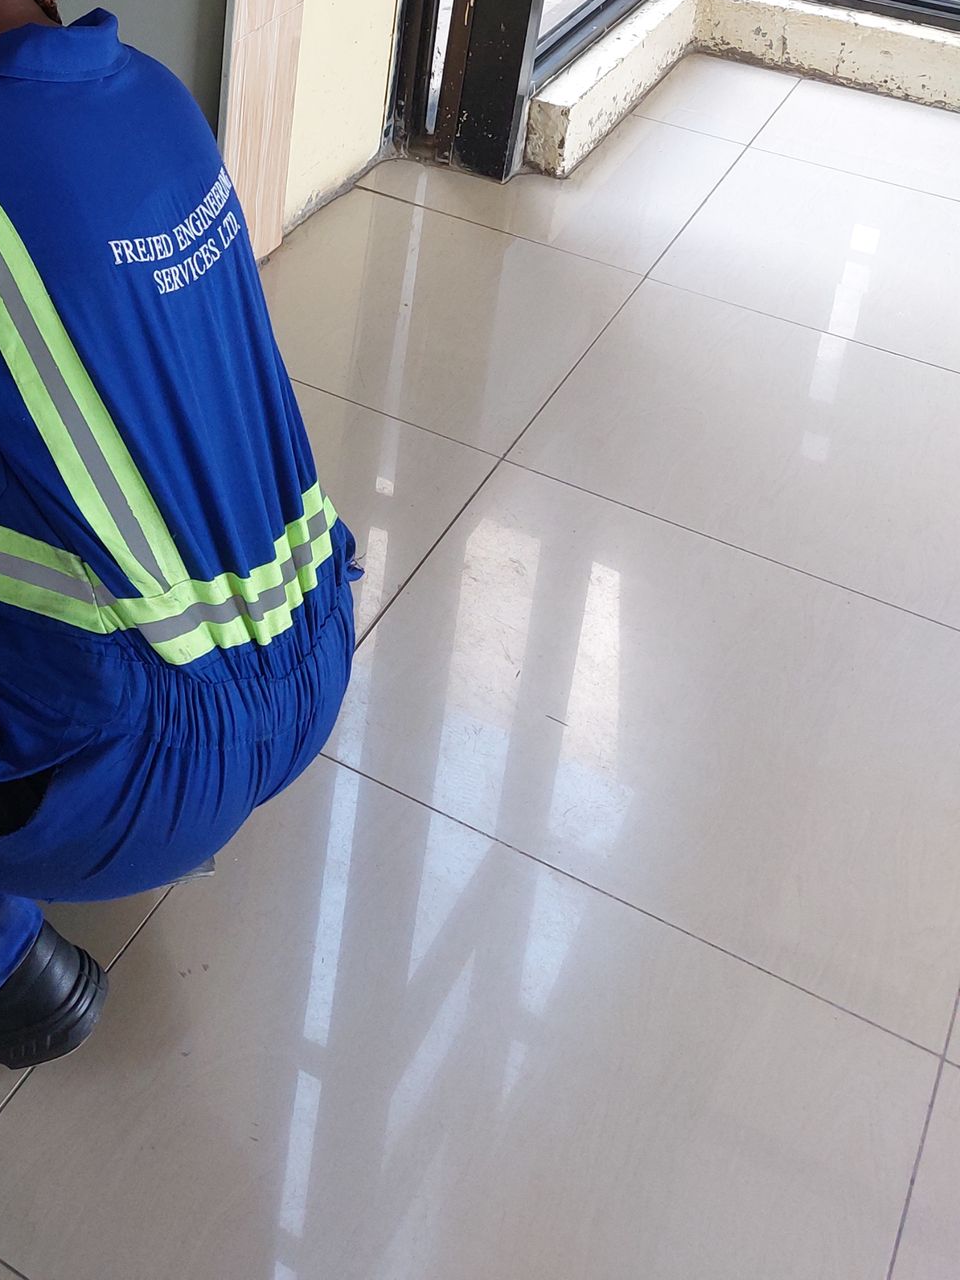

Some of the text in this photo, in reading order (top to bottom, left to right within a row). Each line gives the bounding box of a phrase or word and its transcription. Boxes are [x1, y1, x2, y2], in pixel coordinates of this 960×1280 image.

[108, 234, 173, 265] FREJED
[153, 211, 241, 295] SERVICES LTD.
